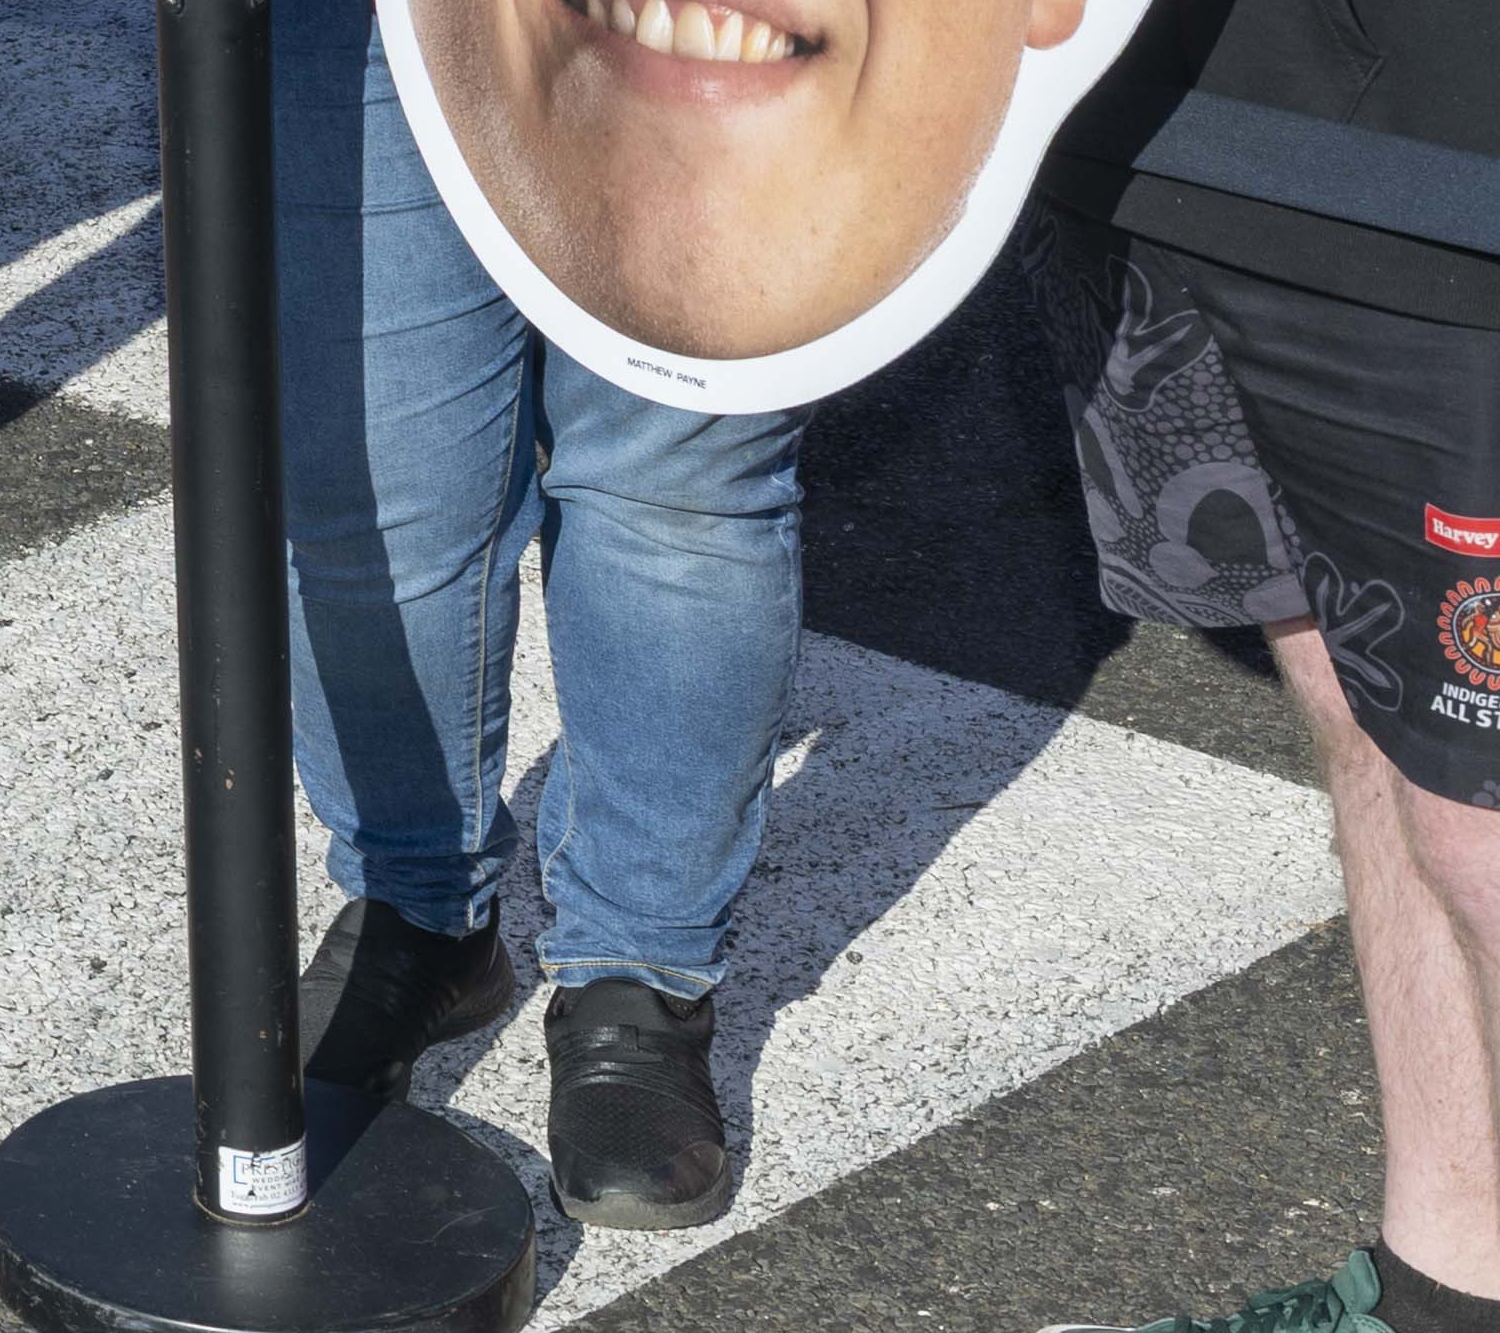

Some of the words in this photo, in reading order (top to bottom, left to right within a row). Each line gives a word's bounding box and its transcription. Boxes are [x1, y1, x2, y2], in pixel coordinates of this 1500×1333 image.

[627, 357, 673, 379] MATTHEW
[676, 371, 708, 390] PAYNE
[1432, 517, 1500, 549] Harvey
[1430, 695, 1471, 723] ALL
[1442, 682, 1500, 709] INDIGE
